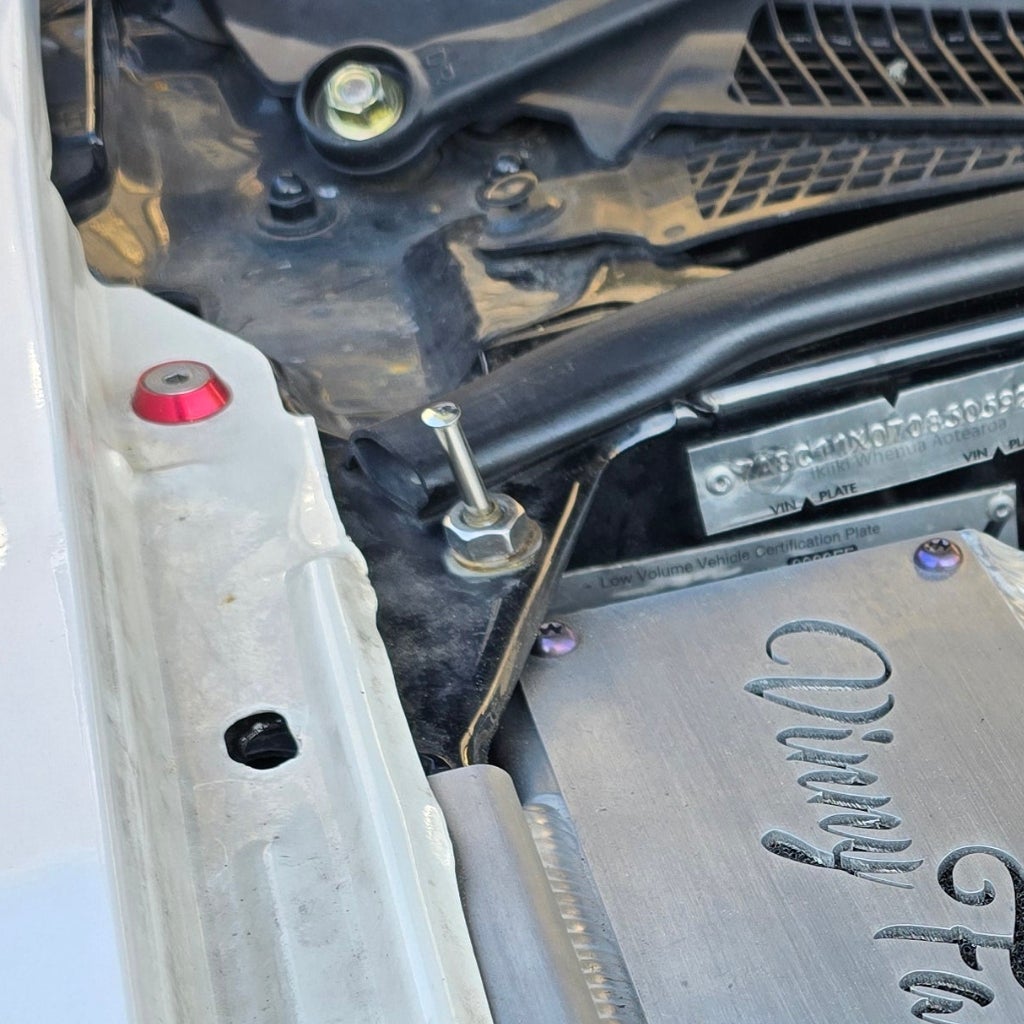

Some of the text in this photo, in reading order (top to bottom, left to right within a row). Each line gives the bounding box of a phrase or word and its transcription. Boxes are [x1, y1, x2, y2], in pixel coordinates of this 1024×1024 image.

[934, 418, 1008, 446] Aotearoa
[963, 448, 988, 463] VIN
[769, 483, 857, 515] VIN PLATE
[600, 574, 633, 589] Low
[637, 562, 694, 582] Volume
[697, 550, 750, 570] Vehicle
[756, 532, 841, 558] Certification
[845, 524, 881, 541] Plate
